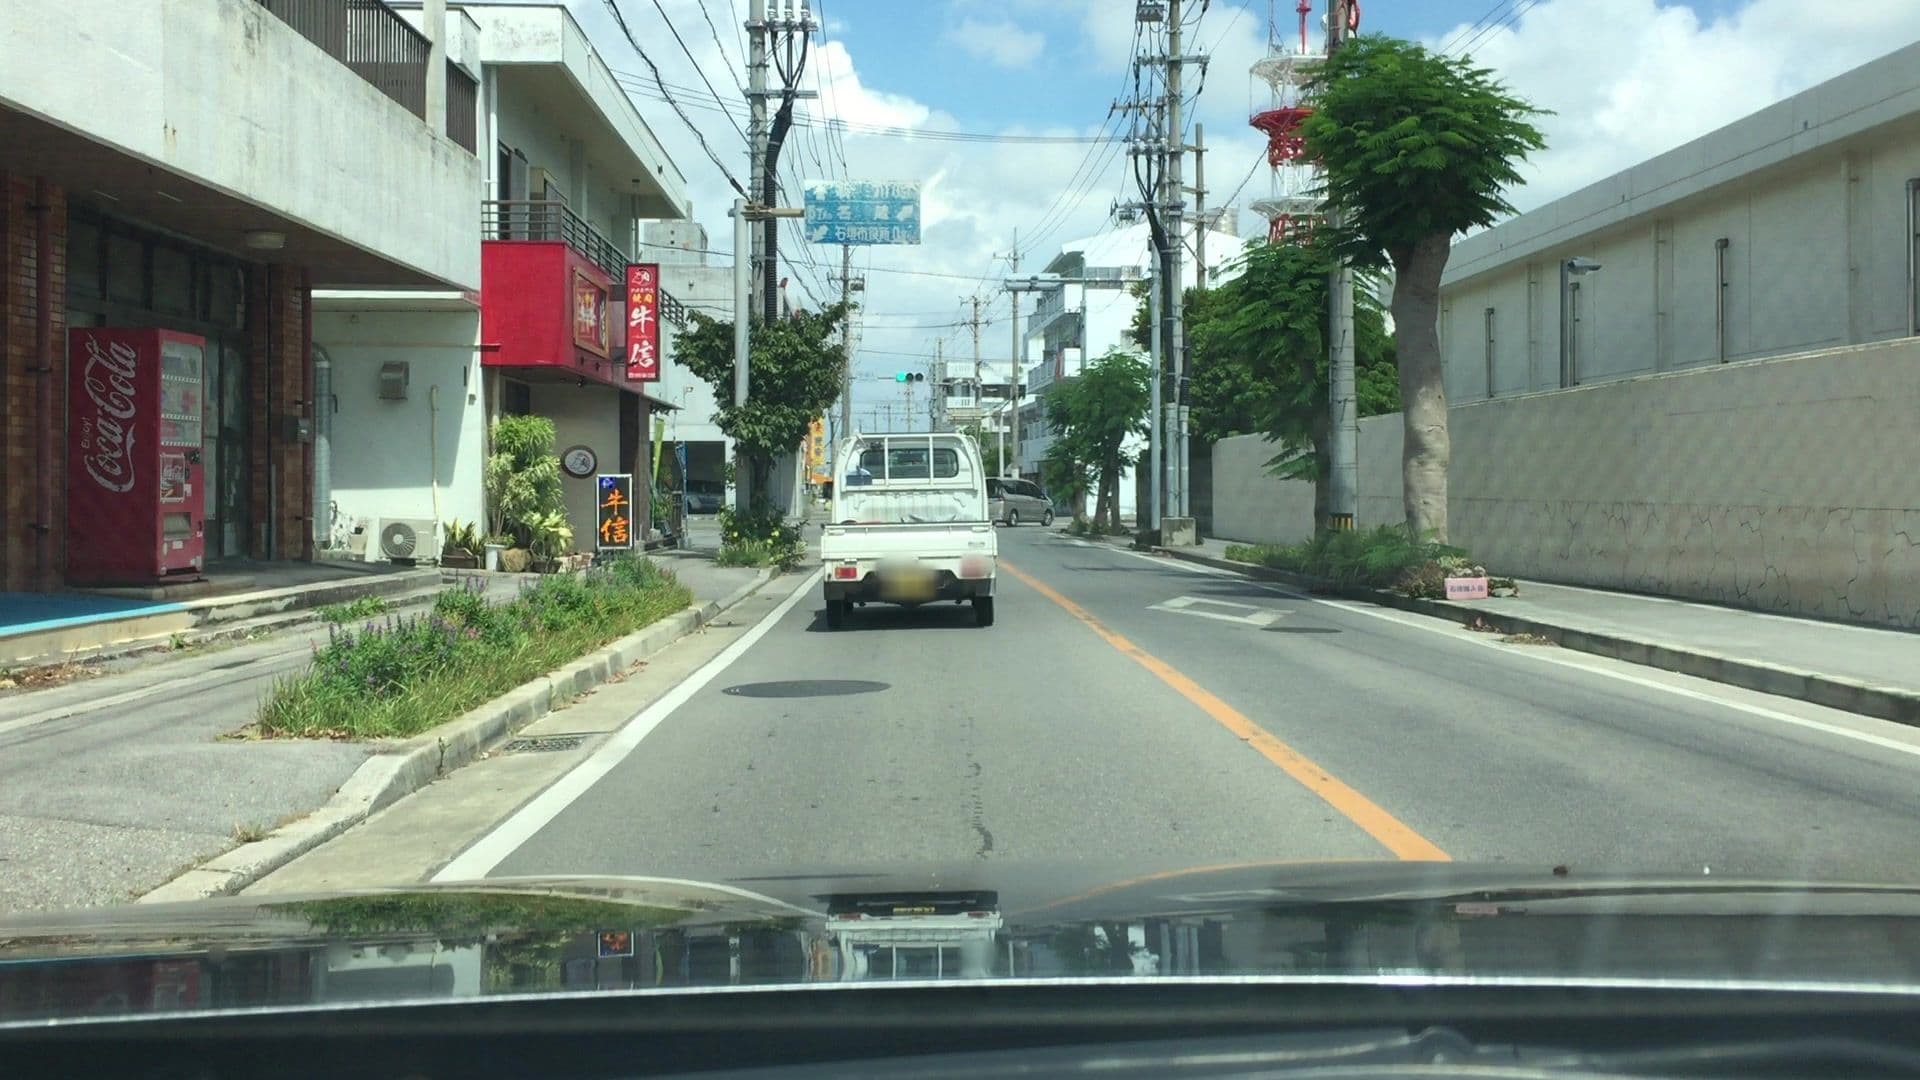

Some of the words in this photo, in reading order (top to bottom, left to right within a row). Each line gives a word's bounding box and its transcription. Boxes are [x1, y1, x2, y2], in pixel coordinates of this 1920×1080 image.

[629, 305, 655, 368] 牛信
[84, 333, 137, 493] Coca-Cola
[600, 488, 629, 543] 牛信
